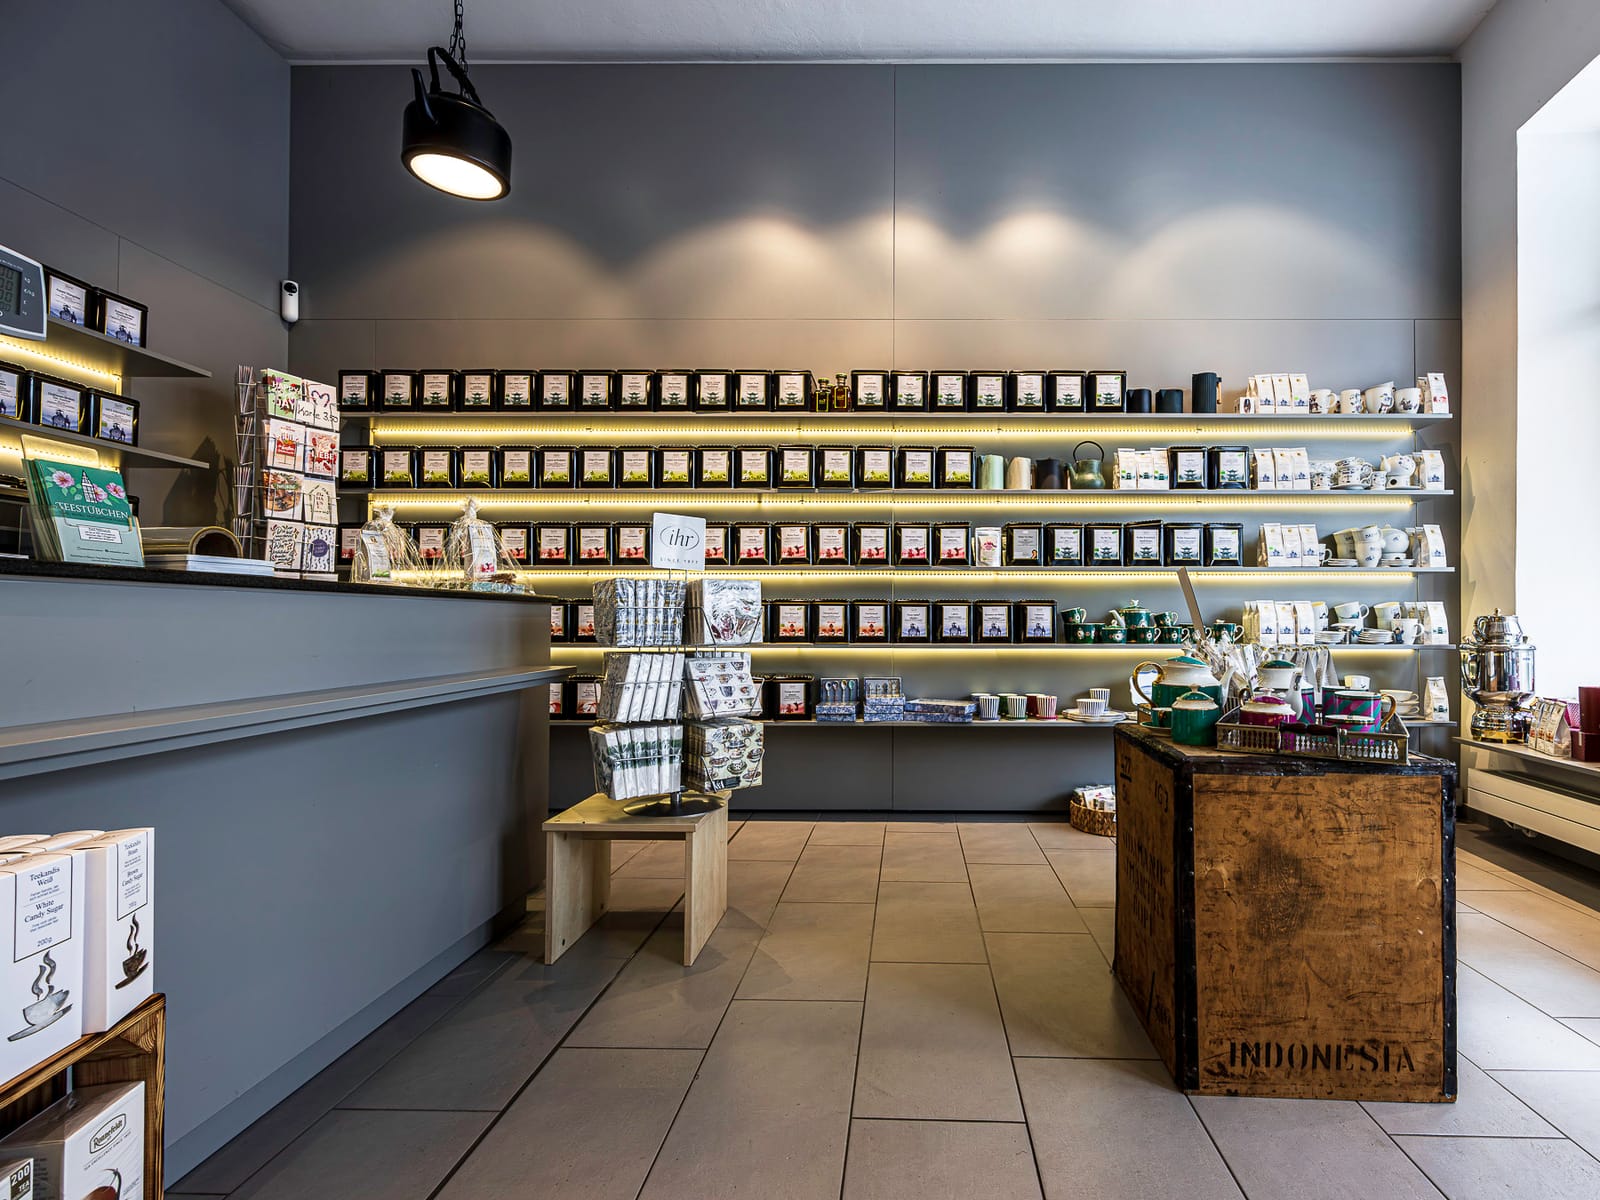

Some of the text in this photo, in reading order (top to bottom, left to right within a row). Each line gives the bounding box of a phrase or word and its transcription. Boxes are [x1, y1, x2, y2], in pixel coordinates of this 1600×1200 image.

[669, 528, 695, 547] ihr
[24, 903, 64, 923] Candy Sugar
[35, 899, 55, 911] White
[1230, 1041, 1415, 1073] INDONESIA
[11, 1164, 30, 1187] 200
[19, 1180, 30, 1192] TEA
